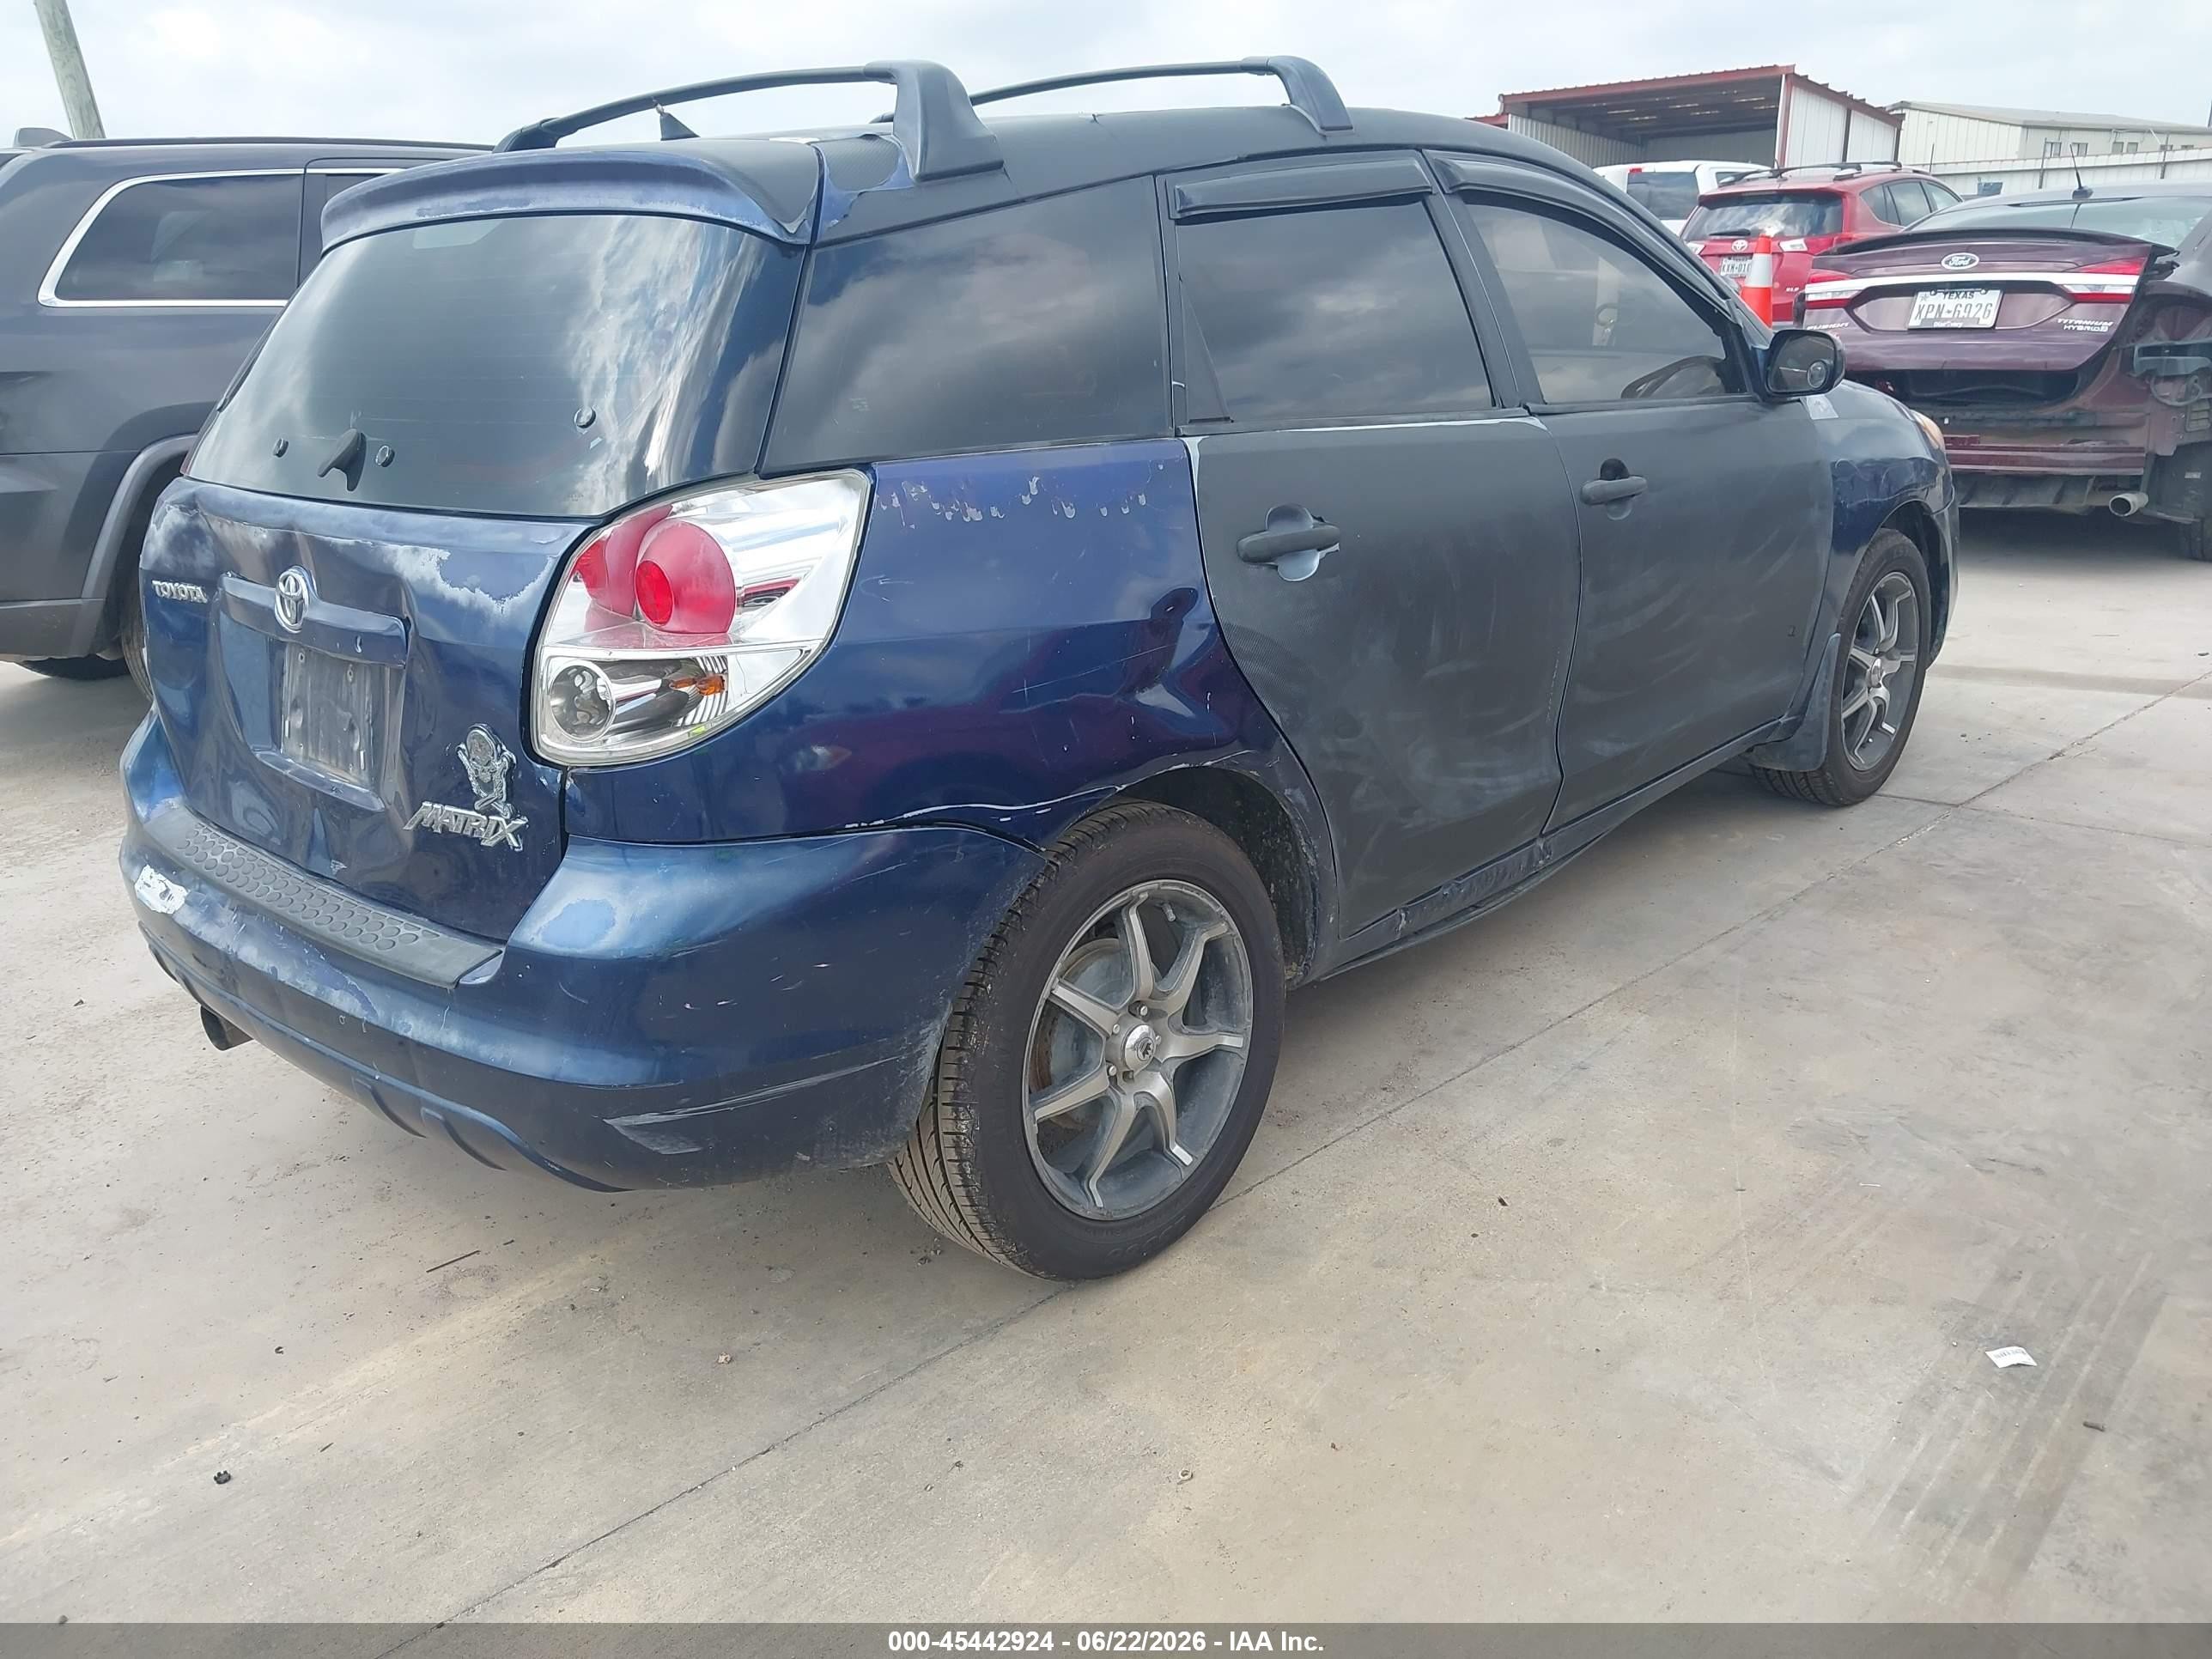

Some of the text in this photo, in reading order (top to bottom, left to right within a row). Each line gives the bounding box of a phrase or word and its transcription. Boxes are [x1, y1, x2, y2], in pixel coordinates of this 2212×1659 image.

[1948, 256, 1972, 267] Ford
[1942, 291, 1975, 301] TEXAS
[152, 580, 208, 603] TOYOTA
[403, 800, 529, 851] MATRIX
